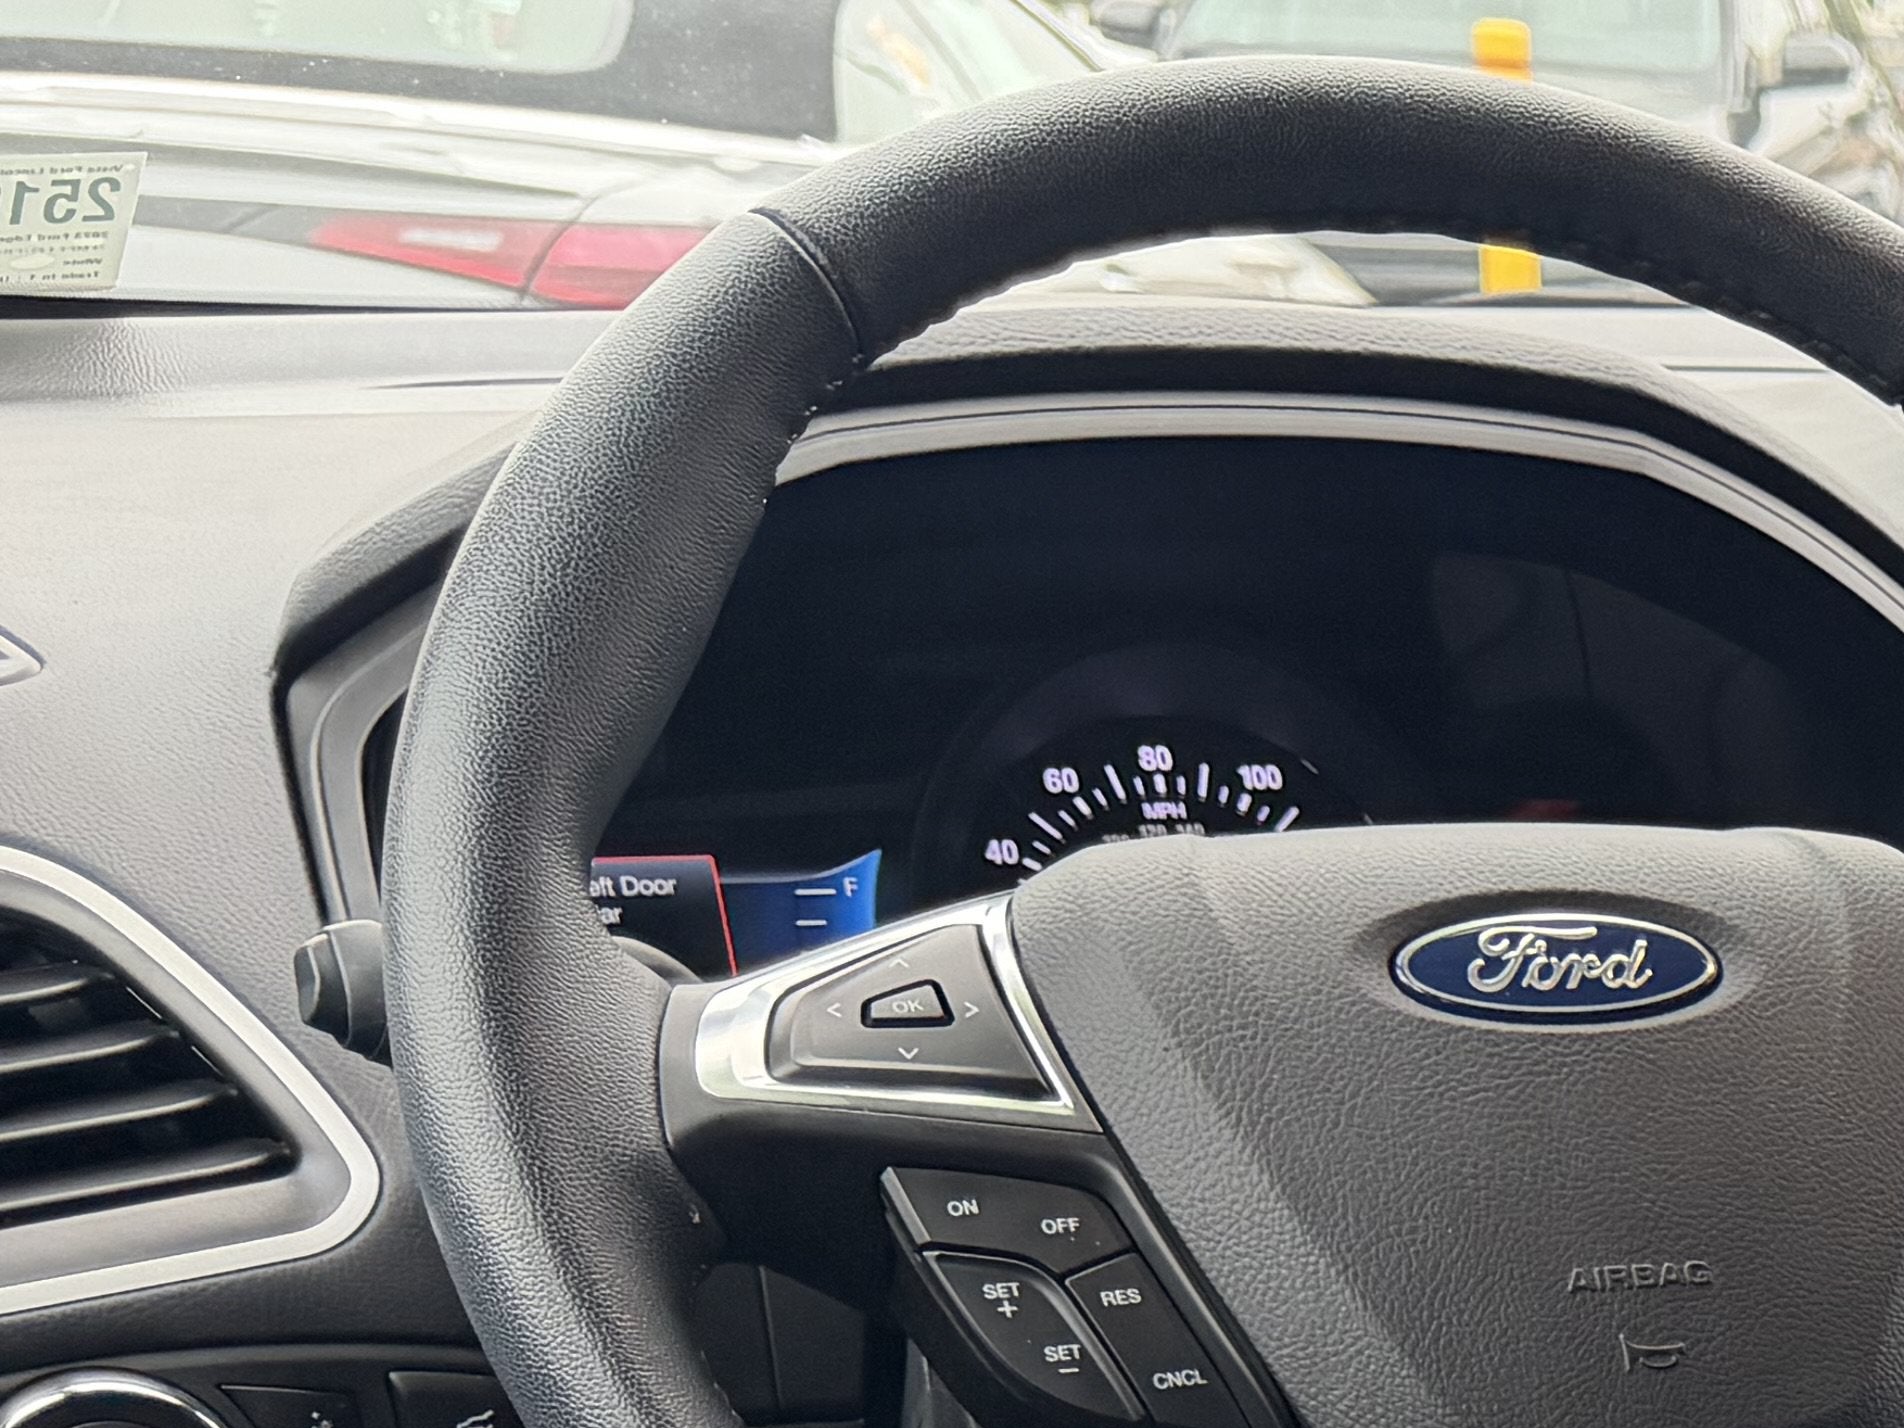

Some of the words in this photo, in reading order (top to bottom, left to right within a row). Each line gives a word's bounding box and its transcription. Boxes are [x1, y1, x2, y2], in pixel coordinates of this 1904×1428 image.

[1137, 744, 1173, 771] 80
[1043, 765, 1080, 794] 60
[1236, 763, 1283, 791] 100
[1141, 801, 1188, 820] MPH
[985, 838, 1020, 866] 40
[619, 875, 677, 897] Door
[843, 876, 859, 898] F
[1468, 921, 1654, 994] Ford
[890, 996, 927, 1017] OK
[947, 1199, 980, 1217] ON
[1041, 1217, 1080, 1235] OFF
[1567, 1259, 1713, 1294] AIRBAG
[982, 1282, 1020, 1300] SET
[1100, 1287, 1142, 1307] RES
[1044, 1343, 1081, 1362] SET
[1152, 1368, 1208, 1390] CNCL
